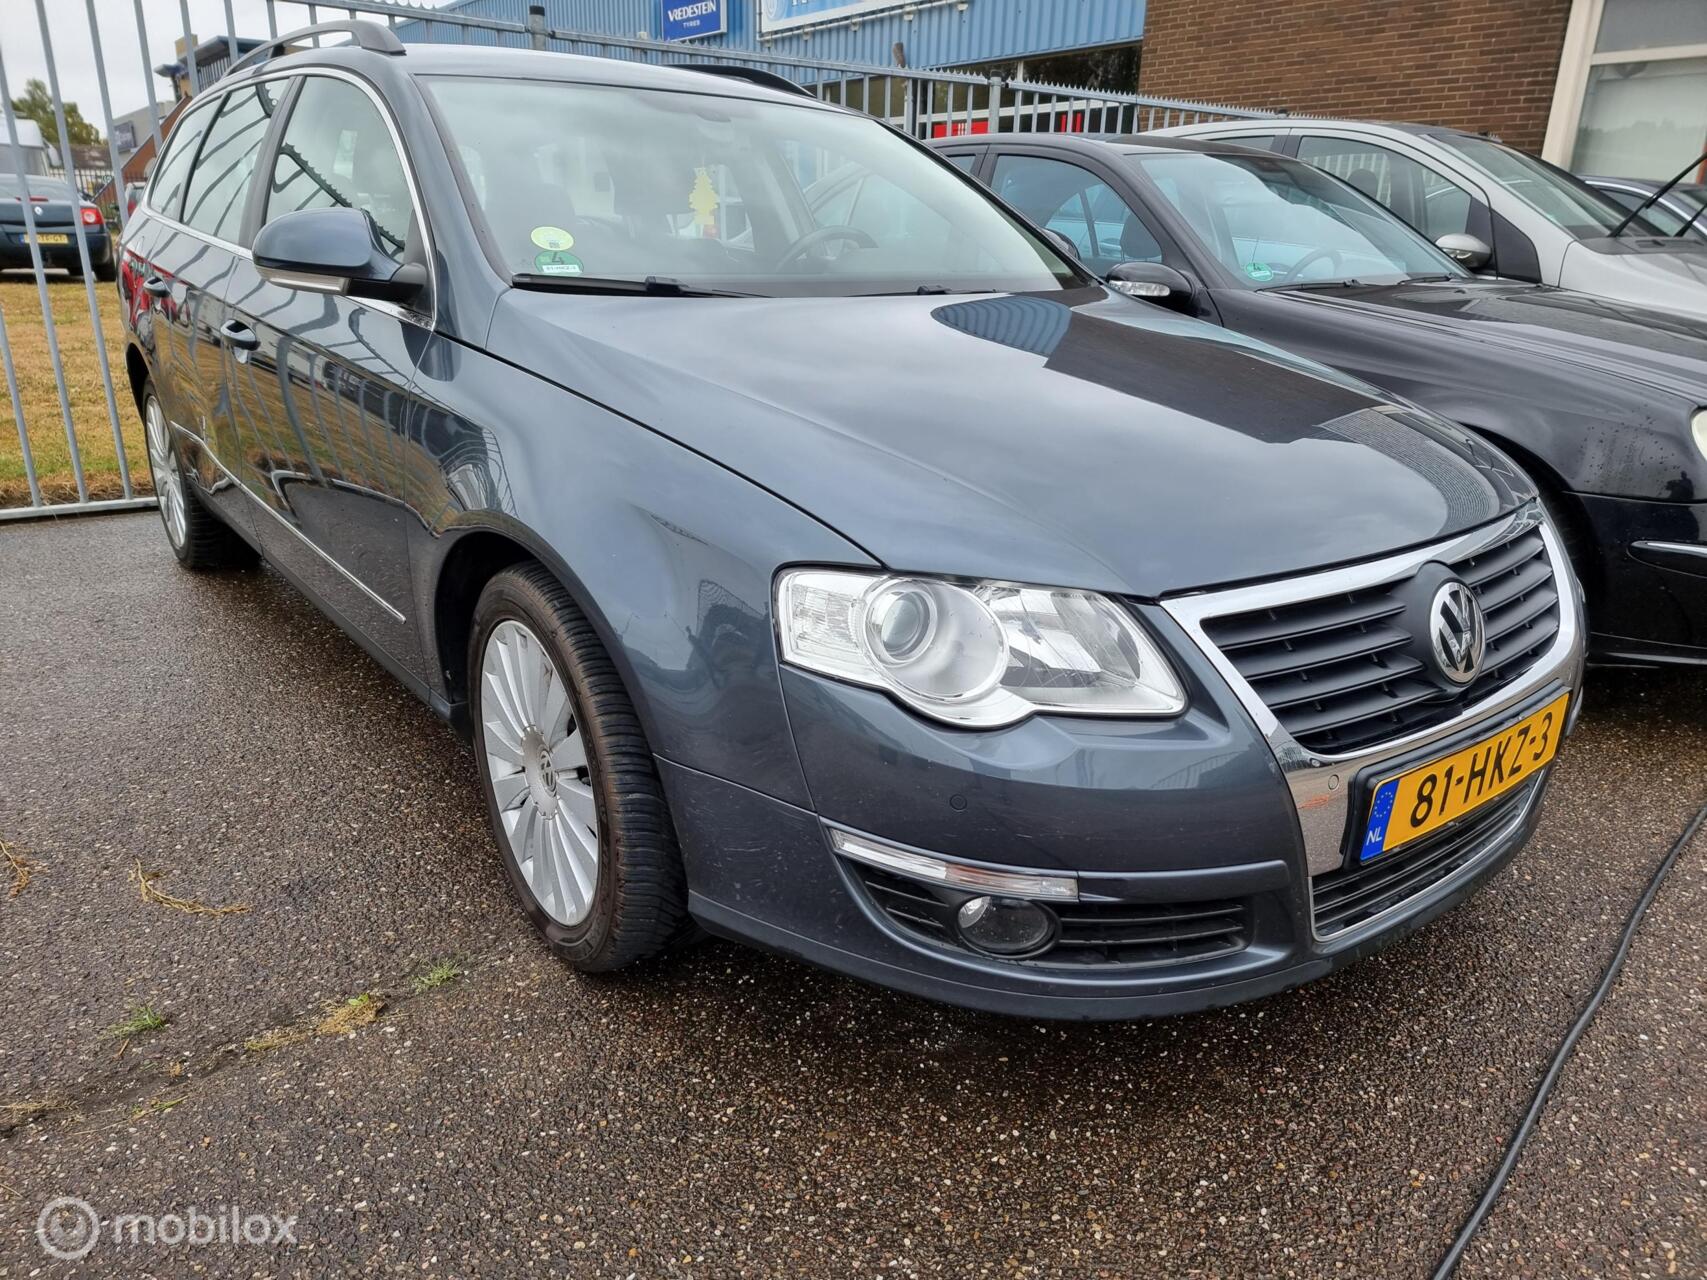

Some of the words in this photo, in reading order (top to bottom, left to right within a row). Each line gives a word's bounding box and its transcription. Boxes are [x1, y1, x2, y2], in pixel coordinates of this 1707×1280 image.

[667, 0, 716, 21] VREDESTEIN
[1410, 711, 1554, 828] 81-HKZ-3
[1366, 828, 1382, 846] NL
